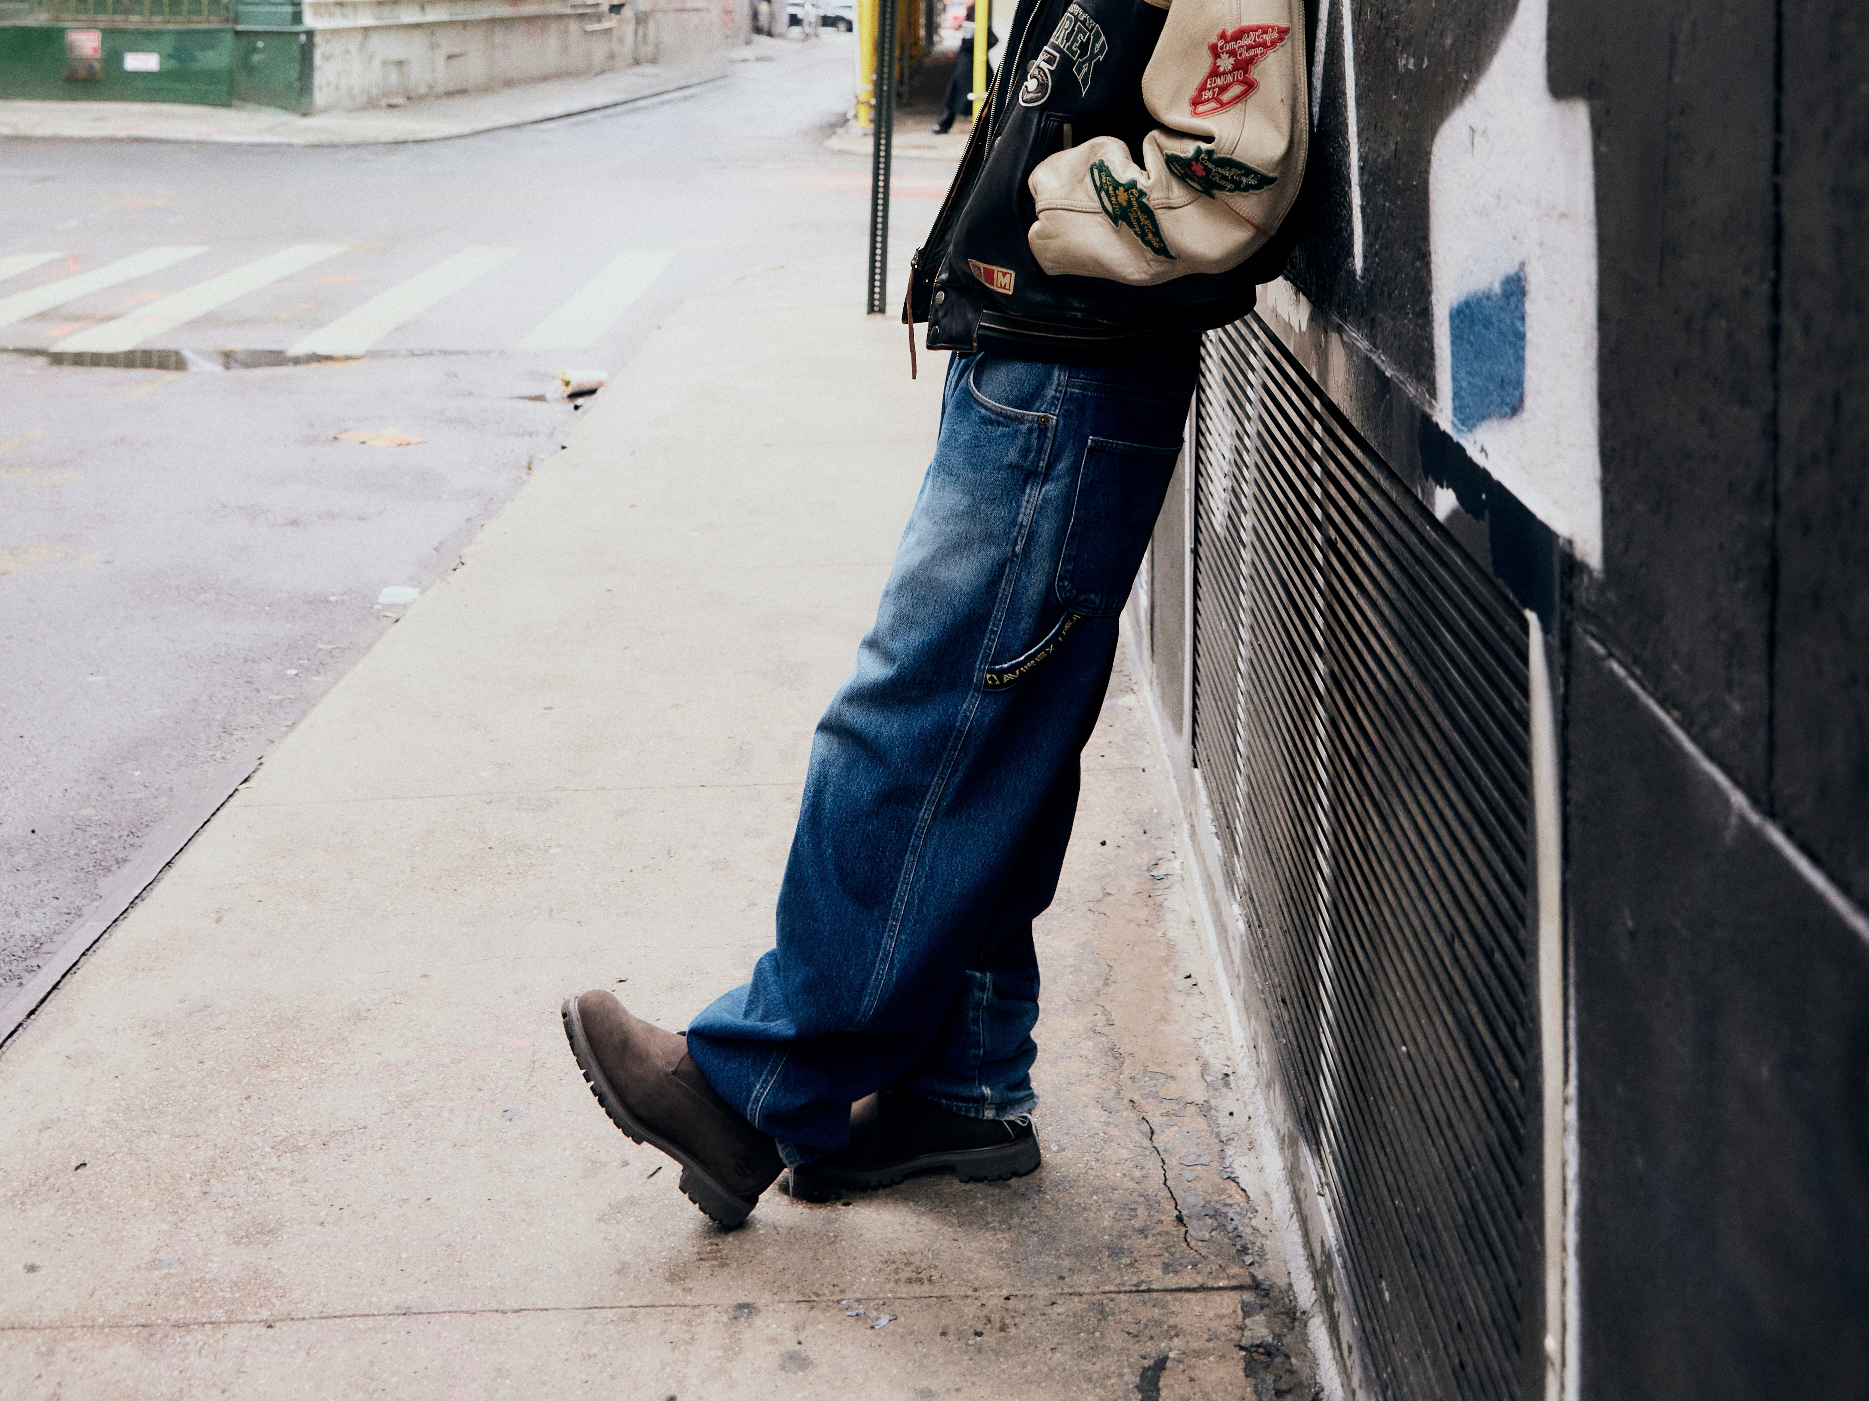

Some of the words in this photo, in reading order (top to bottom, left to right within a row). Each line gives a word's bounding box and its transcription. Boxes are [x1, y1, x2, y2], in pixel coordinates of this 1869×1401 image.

[1217, 31, 1256, 52] Campbell
[1237, 46, 1264, 59] Champ
[1206, 70, 1244, 88] EDMONTO
[1201, 88, 1219, 100] 1967
[1199, 153, 1236, 180] Campbell
[1209, 171, 1235, 191] Champ
[1003, 644, 1054, 683] AVIREX
